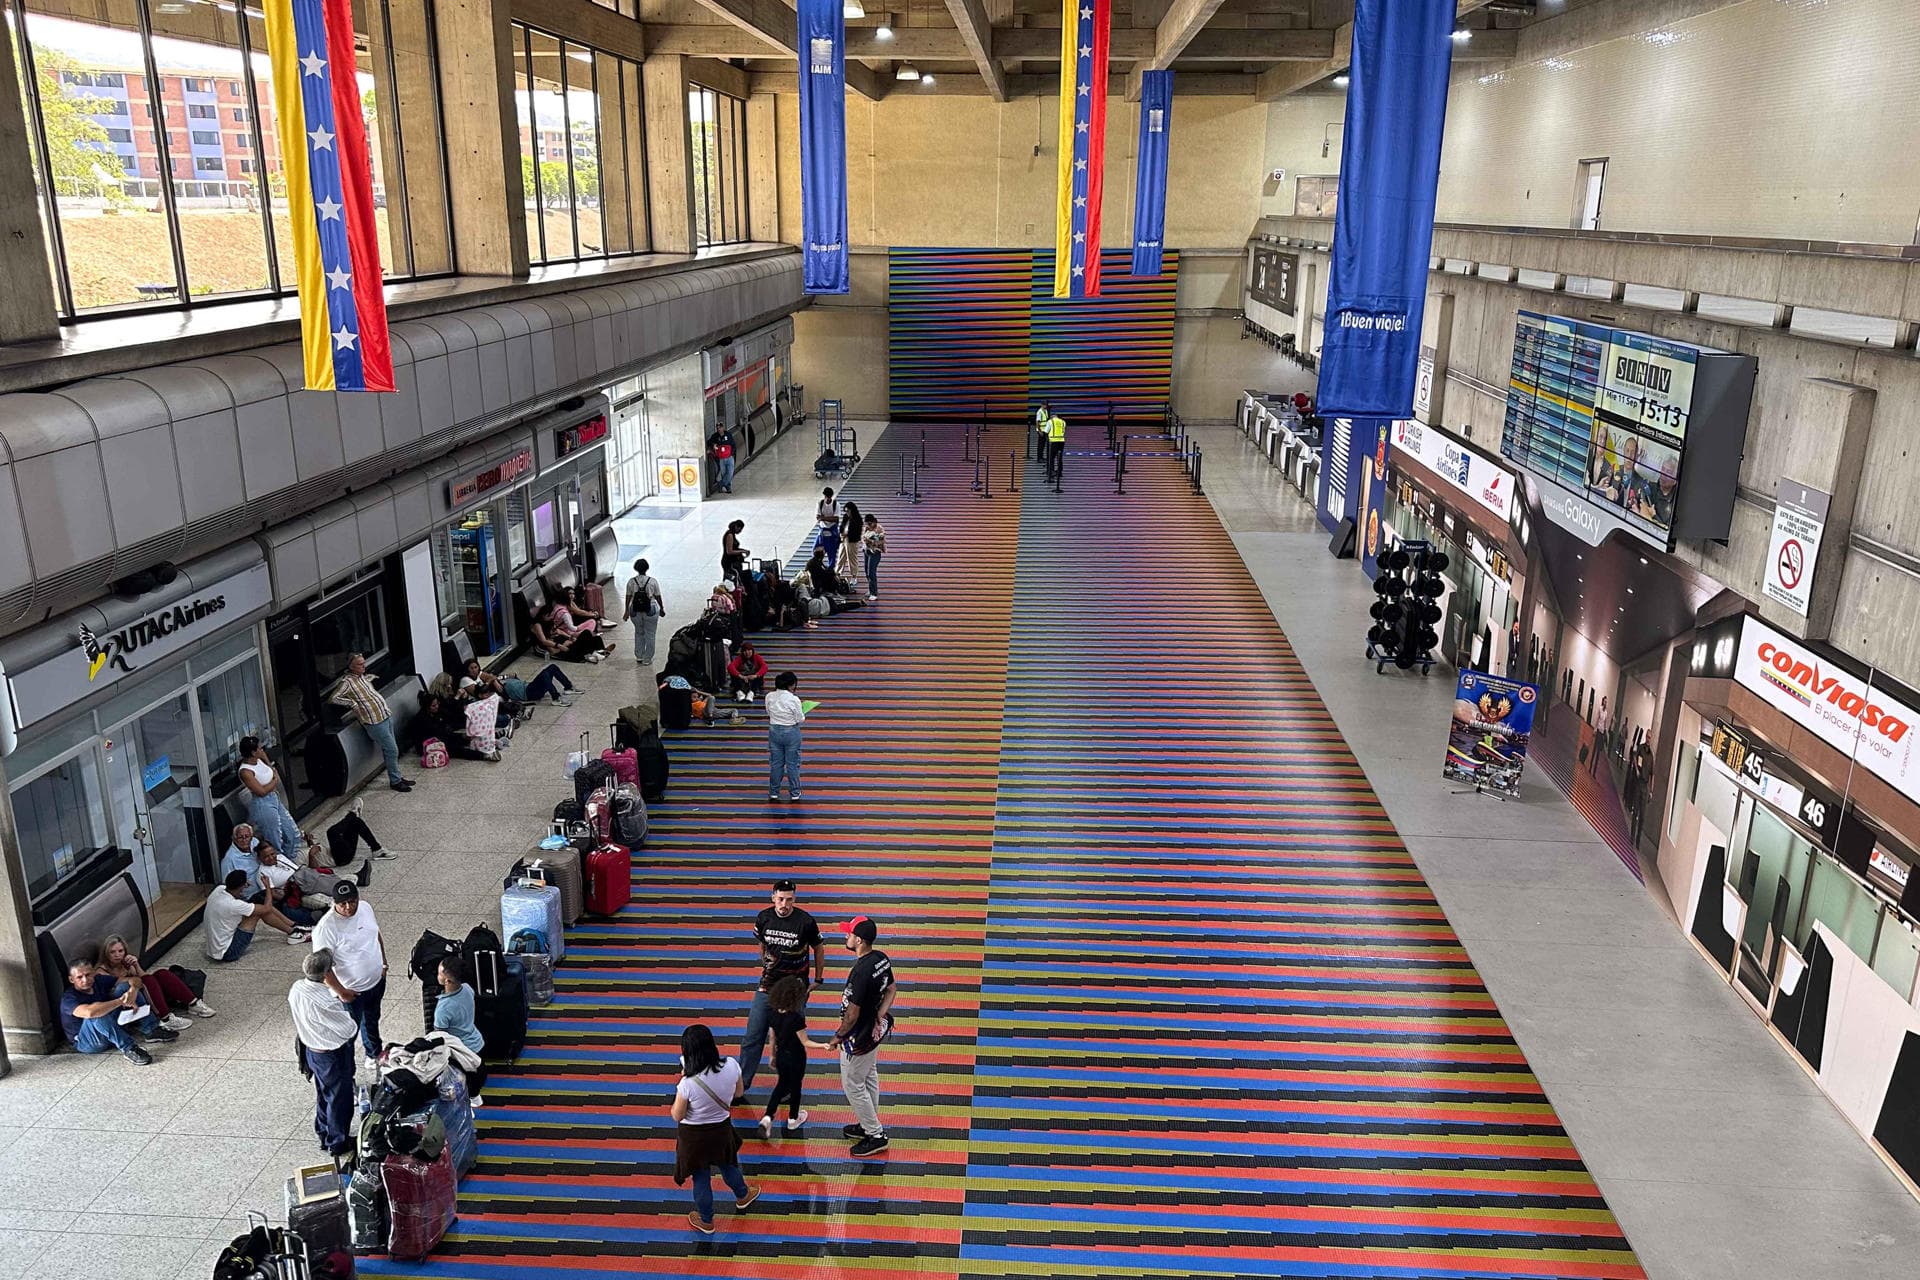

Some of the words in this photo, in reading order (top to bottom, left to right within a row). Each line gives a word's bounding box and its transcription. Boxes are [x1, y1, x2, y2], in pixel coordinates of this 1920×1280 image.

[811, 64, 832, 75] IAIM
[1340, 310, 1373, 329] ¡Buen
[1375, 313, 1405, 332] viaje!
[1616, 356, 1672, 393] SINIV
[1625, 398, 1638, 408] Sep
[1640, 397, 1682, 428] 15:13
[1445, 444, 1459, 464] Copa
[1437, 456, 1457, 480] Airlines
[1482, 488, 1504, 510] IBERIA
[1564, 498, 1600, 540] Galaxy
[1757, 642, 1909, 743] conviasa
[1814, 703, 1822, 714] El
[1822, 706, 1852, 732] placer
[1852, 727, 1867, 743] de
[1868, 735, 1893, 759] volar
[1744, 752, 1763, 778] 45
[1803, 798, 1825, 827] 46
